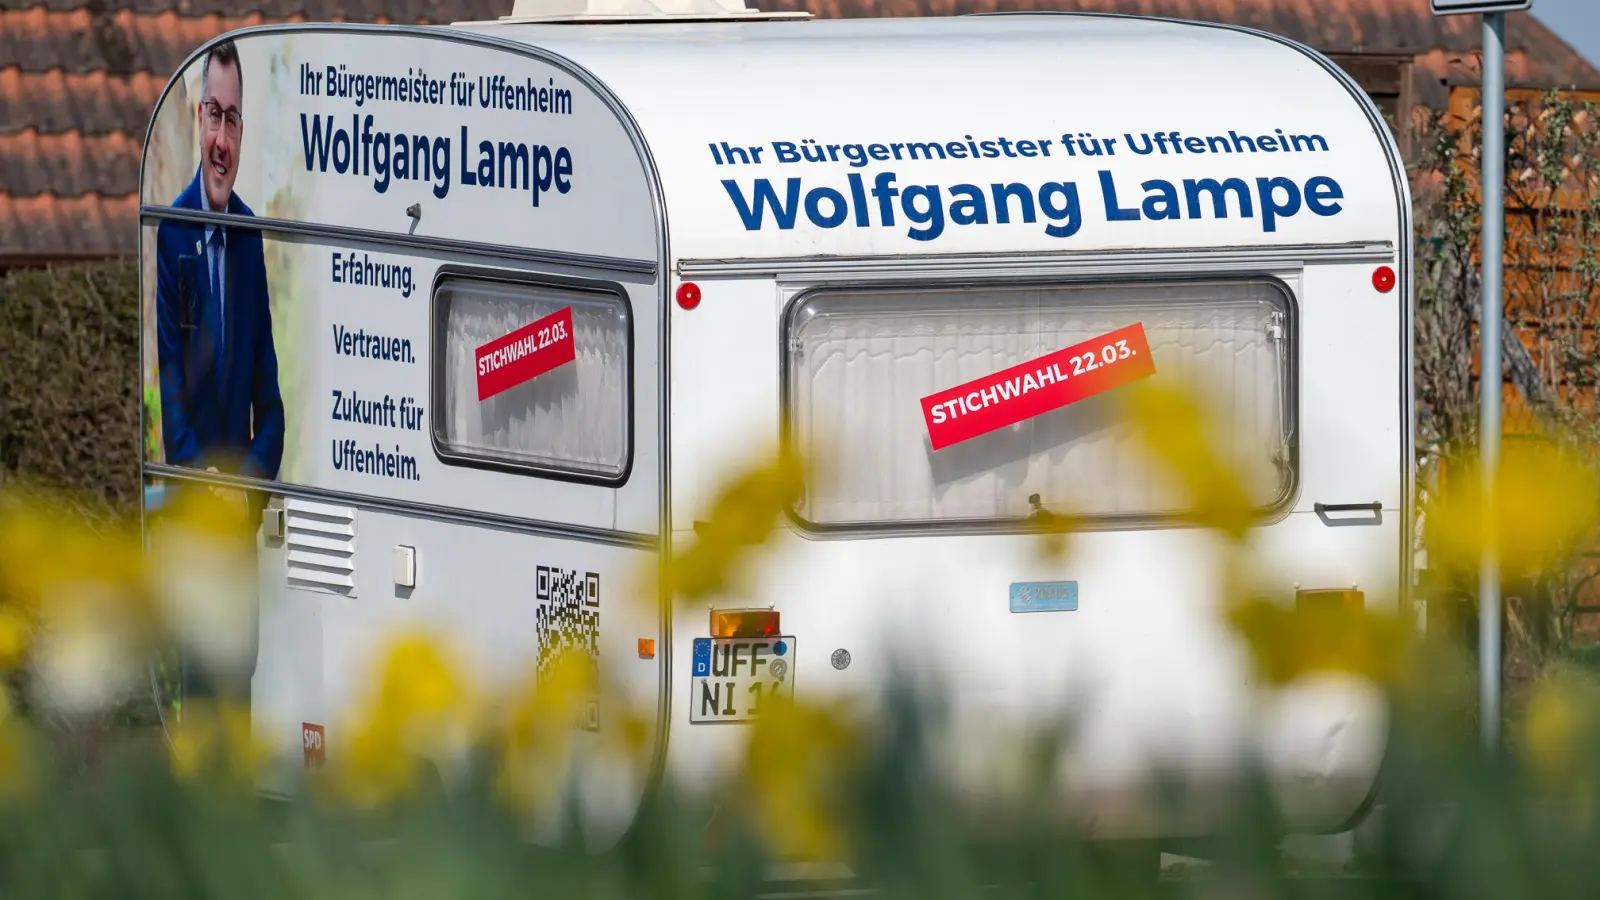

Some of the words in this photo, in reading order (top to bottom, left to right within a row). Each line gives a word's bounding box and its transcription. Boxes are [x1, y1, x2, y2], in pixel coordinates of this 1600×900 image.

[300, 63, 322, 95] Ihr
[326, 64, 447, 107] Bürgermeister
[450, 72, 475, 106] für
[479, 75, 572, 115] Uffenheim
[300, 113, 451, 199] Wolfgang
[460, 125, 573, 208] Lampe
[709, 142, 764, 165] Ihr
[772, 136, 1053, 167] Bürgermeister
[1061, 133, 1117, 156] für
[1125, 129, 1330, 155] Uffenheim
[721, 172, 1082, 241] Wolfgang
[1098, 170, 1344, 232] Lampe
[332, 252, 416, 298] Erfahrung.
[333, 324, 416, 364] Vertrauen.
[478, 340, 538, 376] STICHWAHL
[537, 319, 568, 347] 22.03.
[931, 363, 1068, 424] STICHWAHL
[1069, 339, 1137, 376] 22.03.
[332, 390, 396, 427] Zukunft
[399, 397, 424, 431] für
[332, 438, 420, 481] Uffenheim.
[697, 662, 706, 673] D
[712, 642, 769, 677] UFF
[701, 682, 736, 716] NI
[303, 728, 322, 750] SPD
